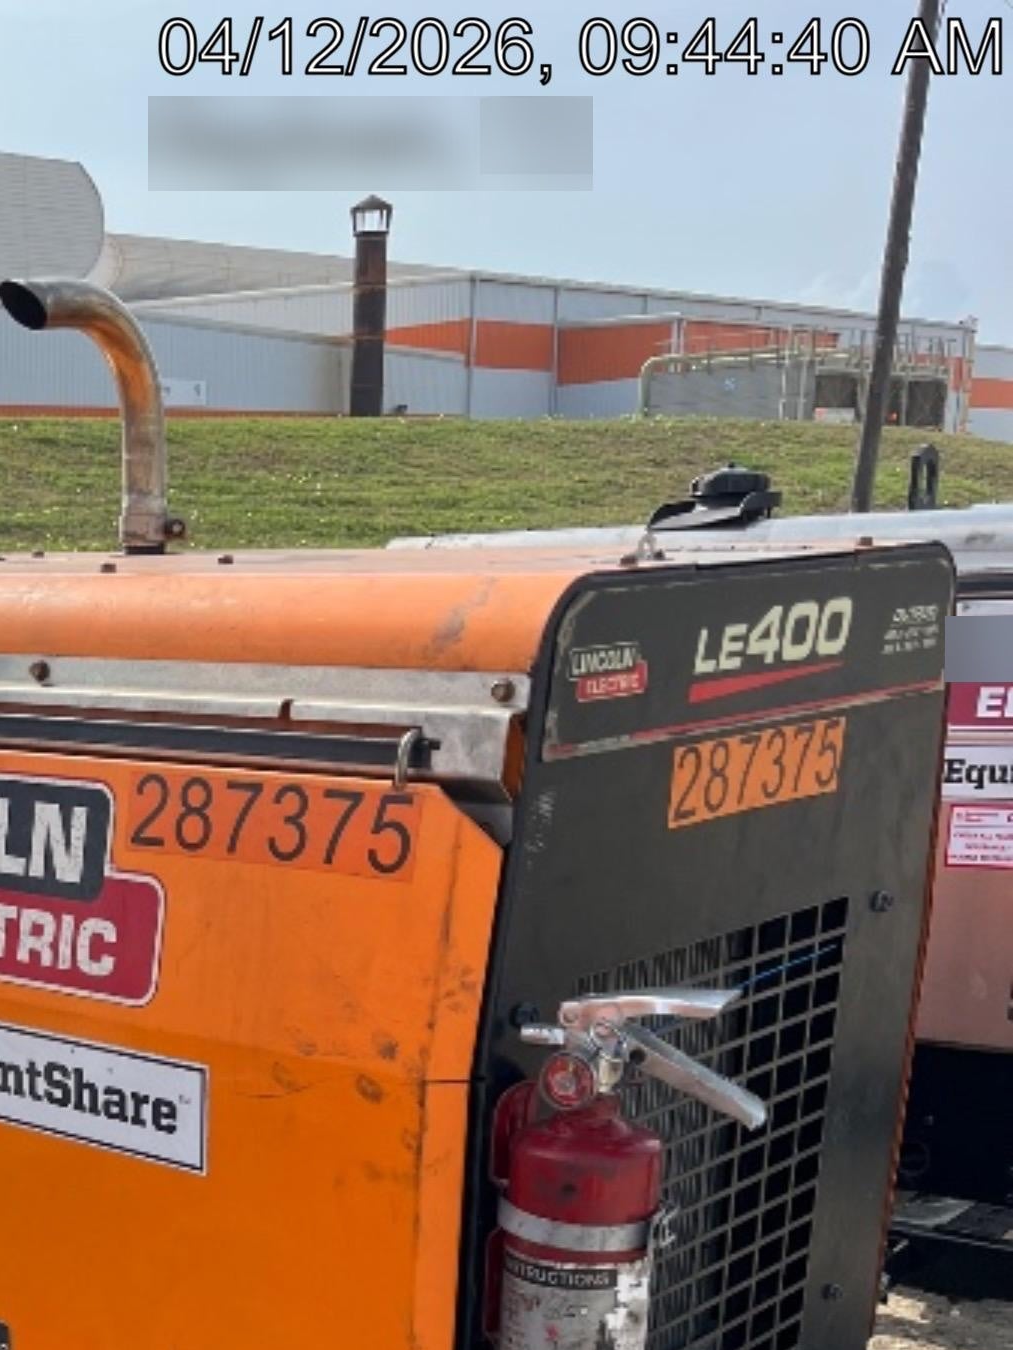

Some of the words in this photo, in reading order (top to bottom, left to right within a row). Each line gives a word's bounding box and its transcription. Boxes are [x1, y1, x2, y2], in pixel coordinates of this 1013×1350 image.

[572, 647, 636, 676] LINCOLN
[694, 597, 853, 676] LE400
[673, 719, 838, 822] 287375
[130, 773, 412, 875] 287375
[506, 1260, 610, 1287] STRUCTIONS
